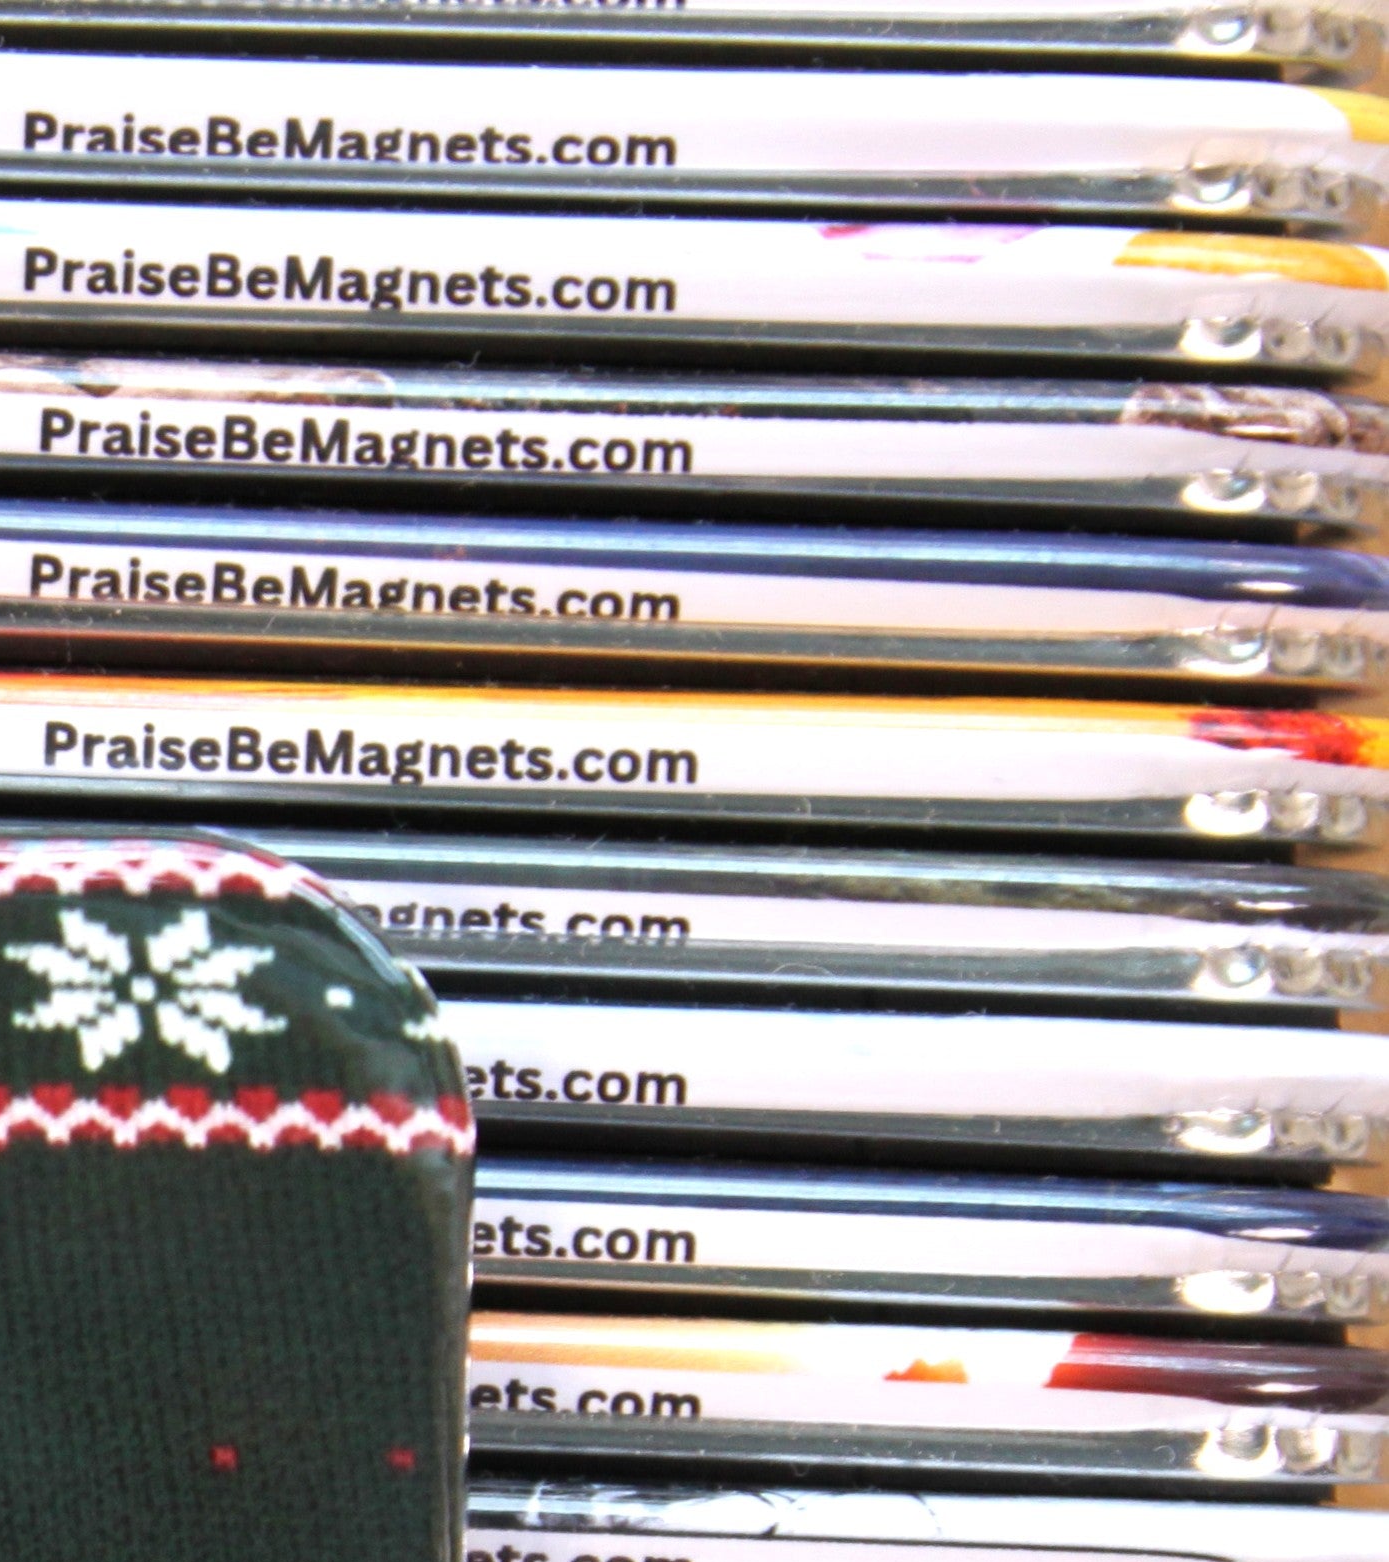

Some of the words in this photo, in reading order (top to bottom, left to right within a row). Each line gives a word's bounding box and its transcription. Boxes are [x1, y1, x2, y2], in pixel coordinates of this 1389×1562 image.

[24, 113, 676, 167] PraiseBeMagnets.com
[24, 247, 676, 312] PraiseBeMagnets.com
[40, 409, 693, 473] PraiseBeMagnets.com
[45, 721, 697, 785] PraiseBeMagnets.com
